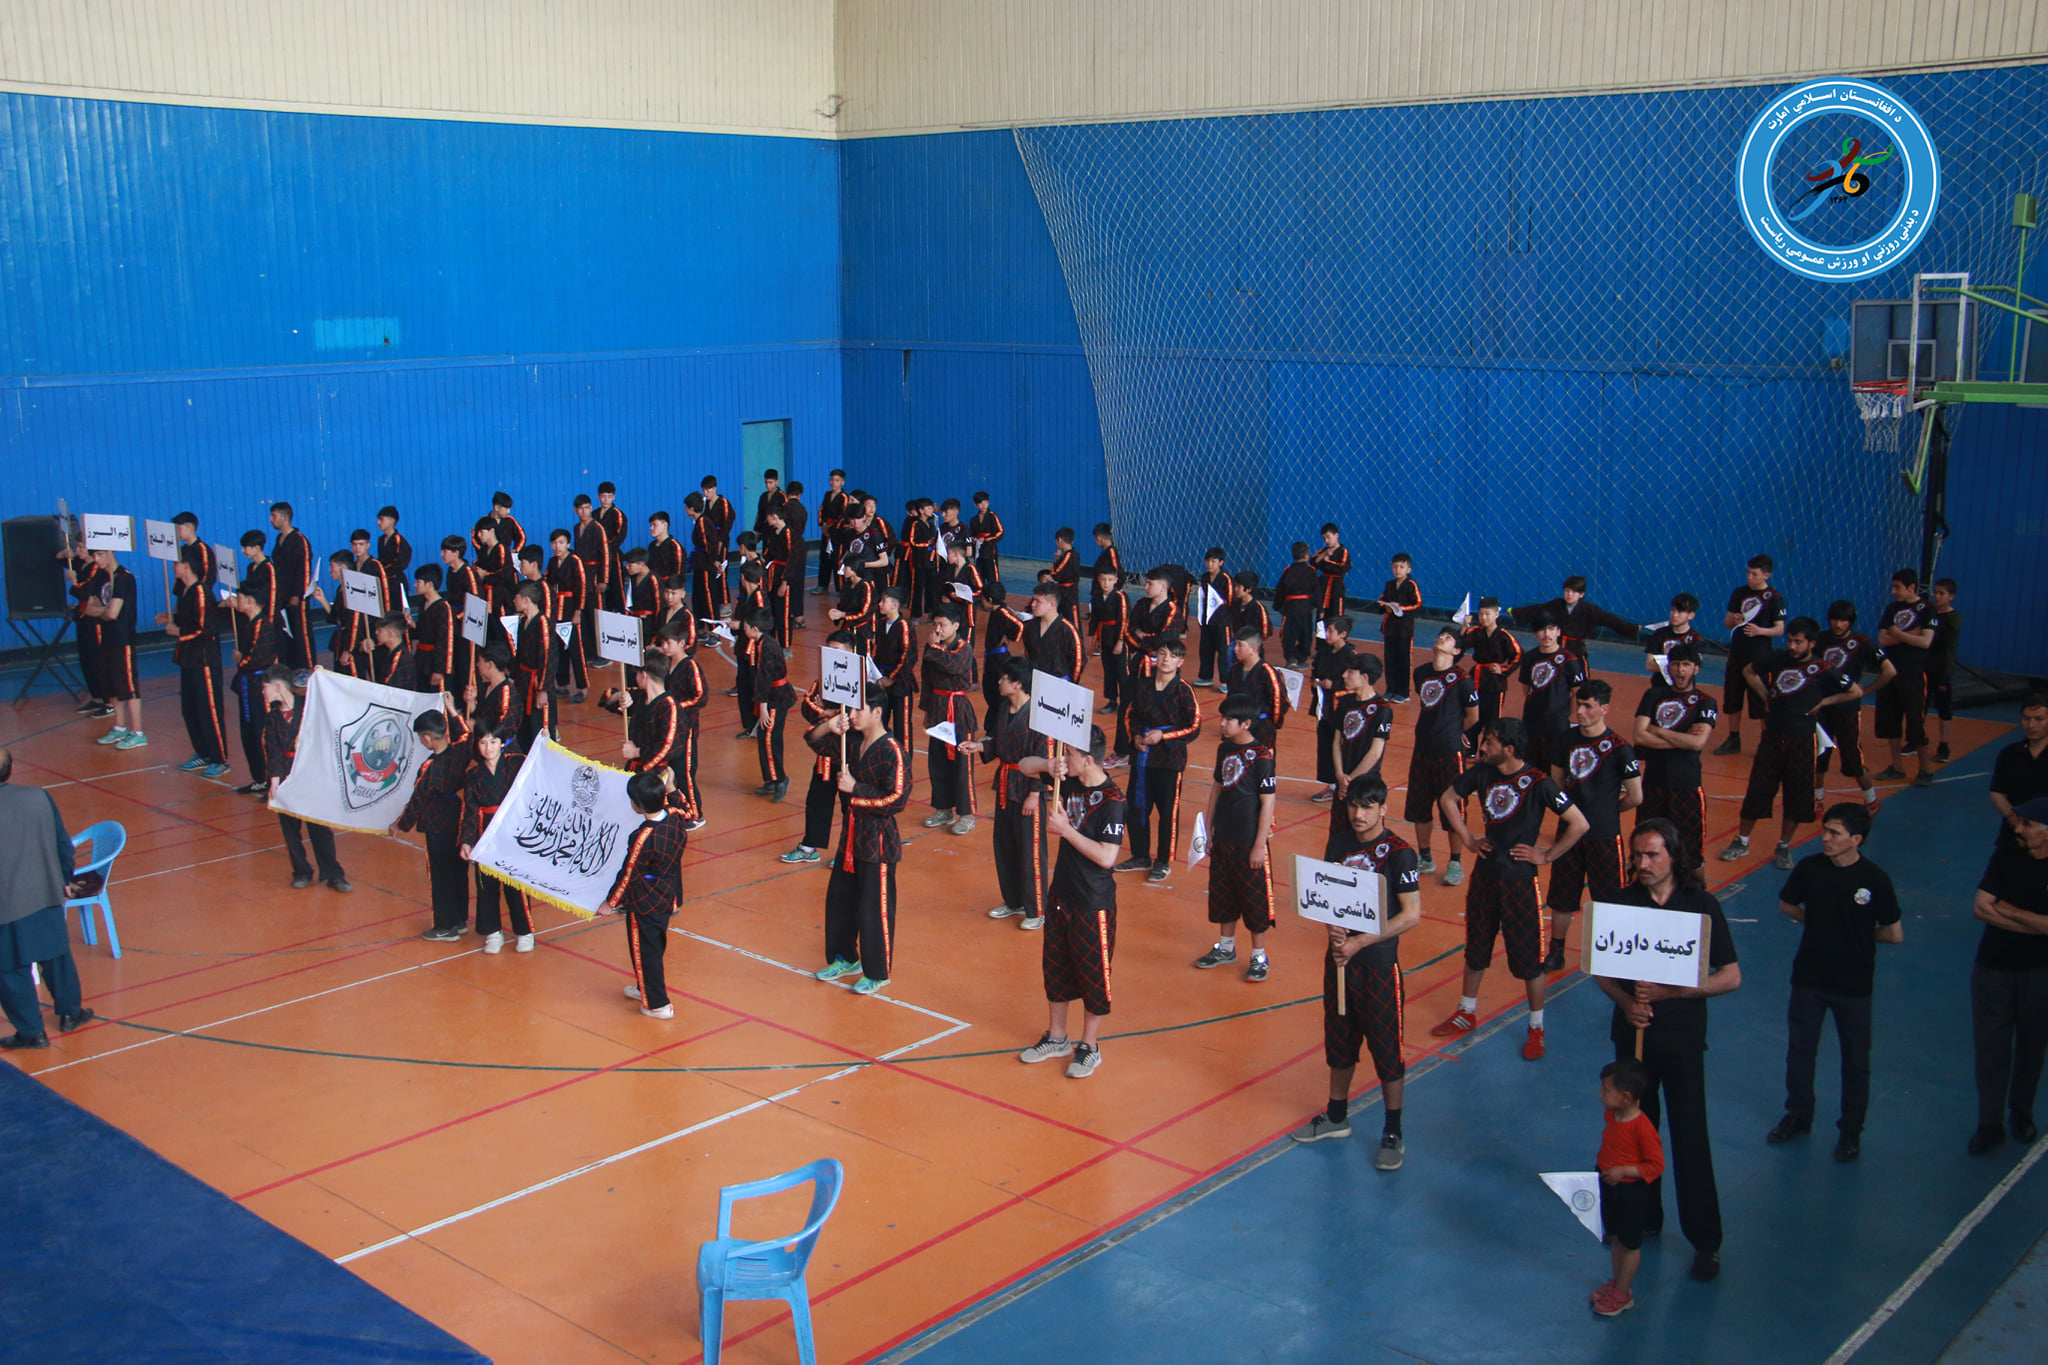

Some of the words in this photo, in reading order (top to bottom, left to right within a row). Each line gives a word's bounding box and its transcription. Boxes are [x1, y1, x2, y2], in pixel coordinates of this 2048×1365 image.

[833, 656, 848, 673] تیم
[1037, 695, 1070, 720] امید
[1071, 709, 1085, 728] تیم
[1314, 872, 1358, 888] تیم
[1300, 889, 1330, 909] منگل
[1333, 901, 1376, 920] هاشمی
[1595, 929, 1649, 955] داوران
[1654, 939, 1697, 959] کمیته
